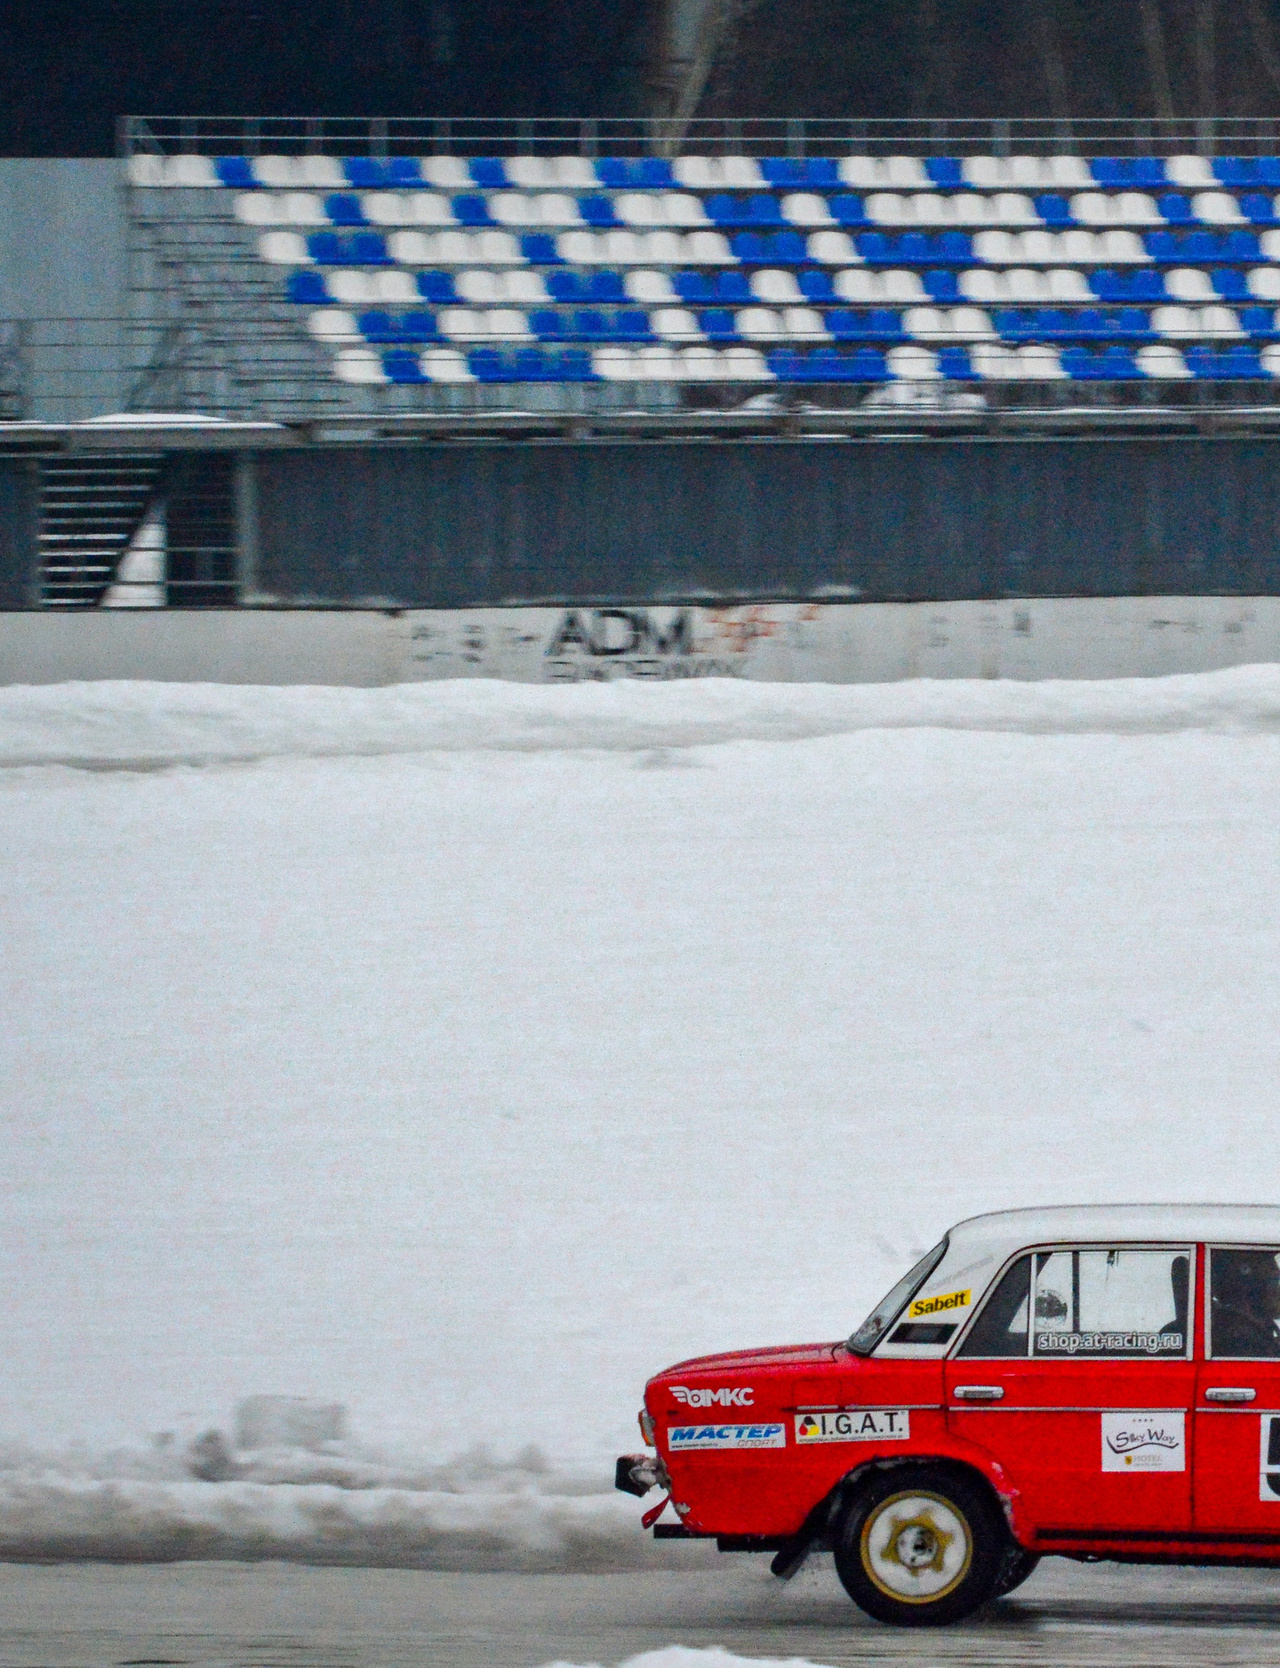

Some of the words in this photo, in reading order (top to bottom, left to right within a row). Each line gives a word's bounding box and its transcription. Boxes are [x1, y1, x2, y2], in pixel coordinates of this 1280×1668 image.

[545, 609, 692, 656] ADM
[913, 1292, 967, 1316] Sabelt
[1037, 1331, 1183, 1353] shop.at-racing.ru
[671, 1425, 783, 1441] МАСТЕР
[822, 1412, 903, 1435] I.G.A.T.
[1147, 1428, 1176, 1444] Way
